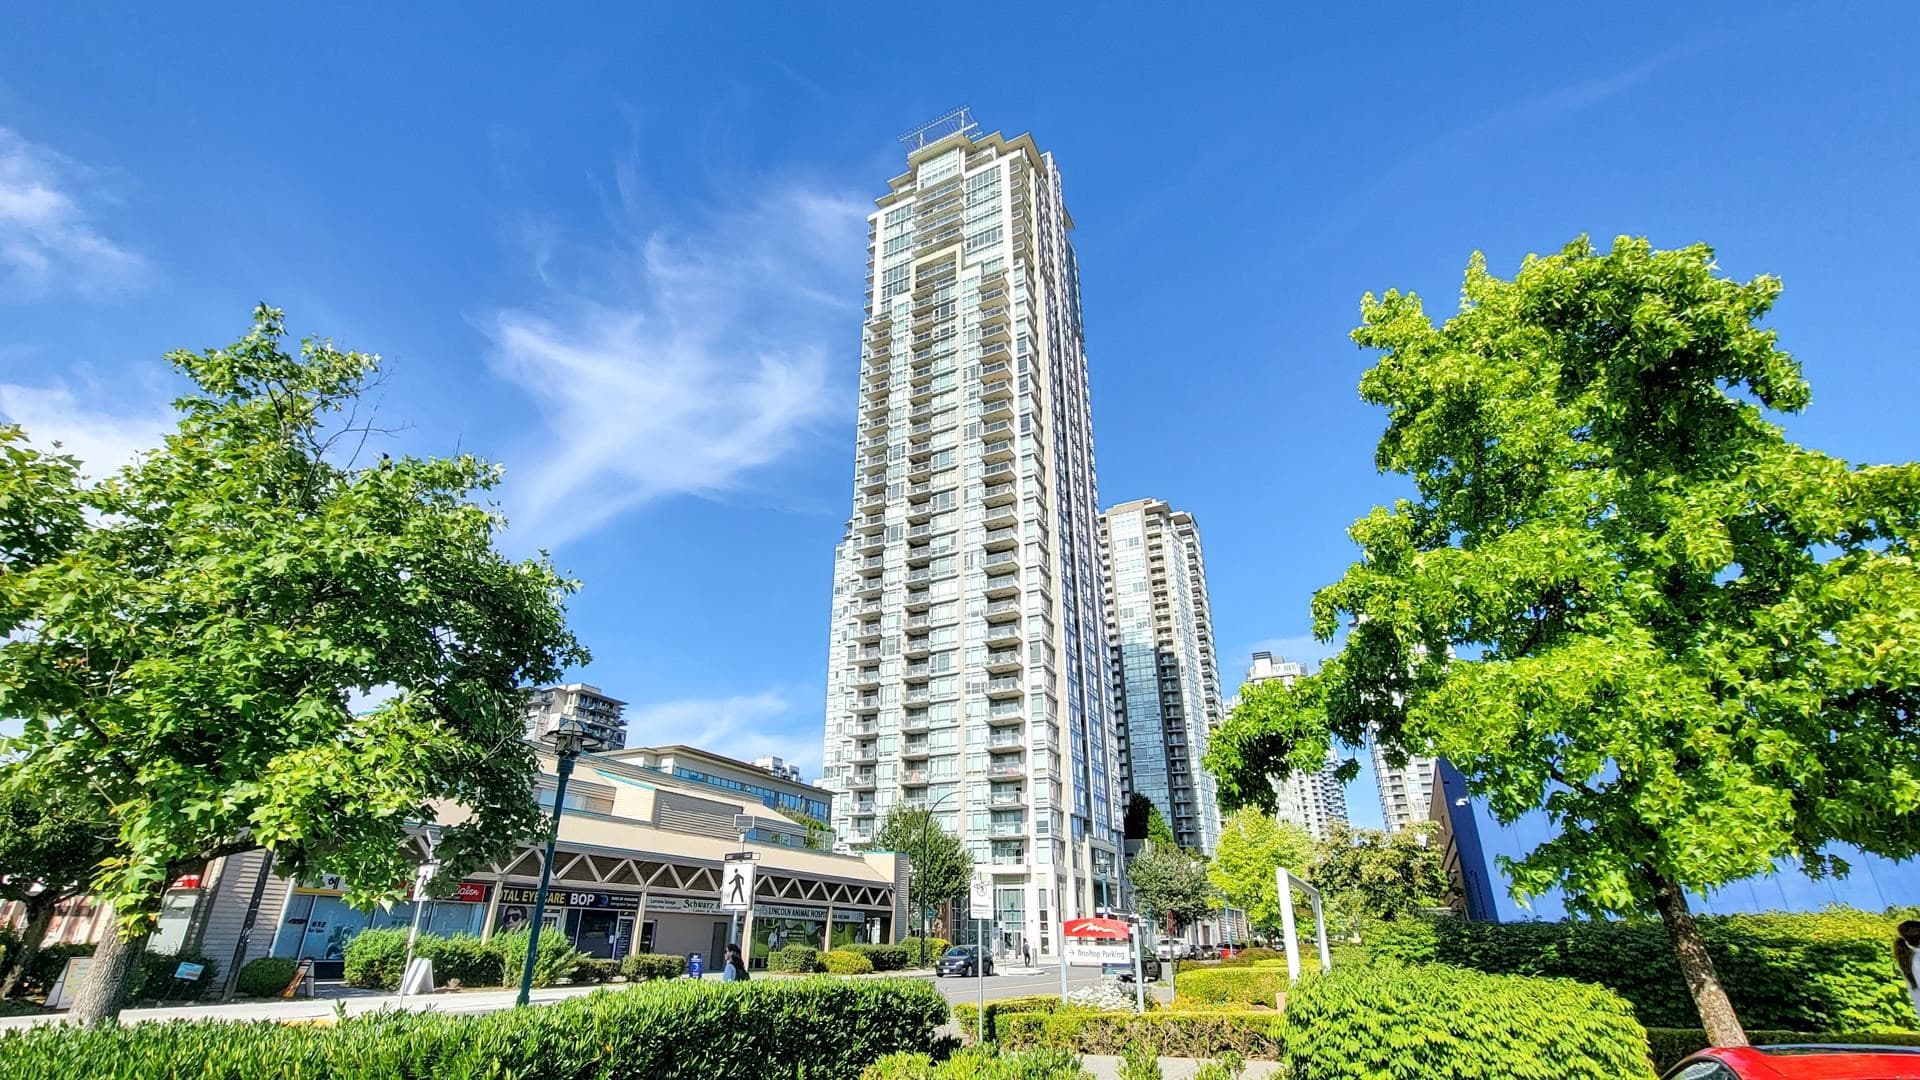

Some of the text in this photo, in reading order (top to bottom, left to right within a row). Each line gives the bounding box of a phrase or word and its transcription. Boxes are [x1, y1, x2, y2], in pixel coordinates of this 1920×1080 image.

[569, 892, 596, 906] BOP
[683, 898, 714, 910] Schwarz
[768, 906, 791, 917] LINCOLN
[792, 908, 810, 918] ANIMAL
[1077, 949, 1125, 960] Rooftop Parking
